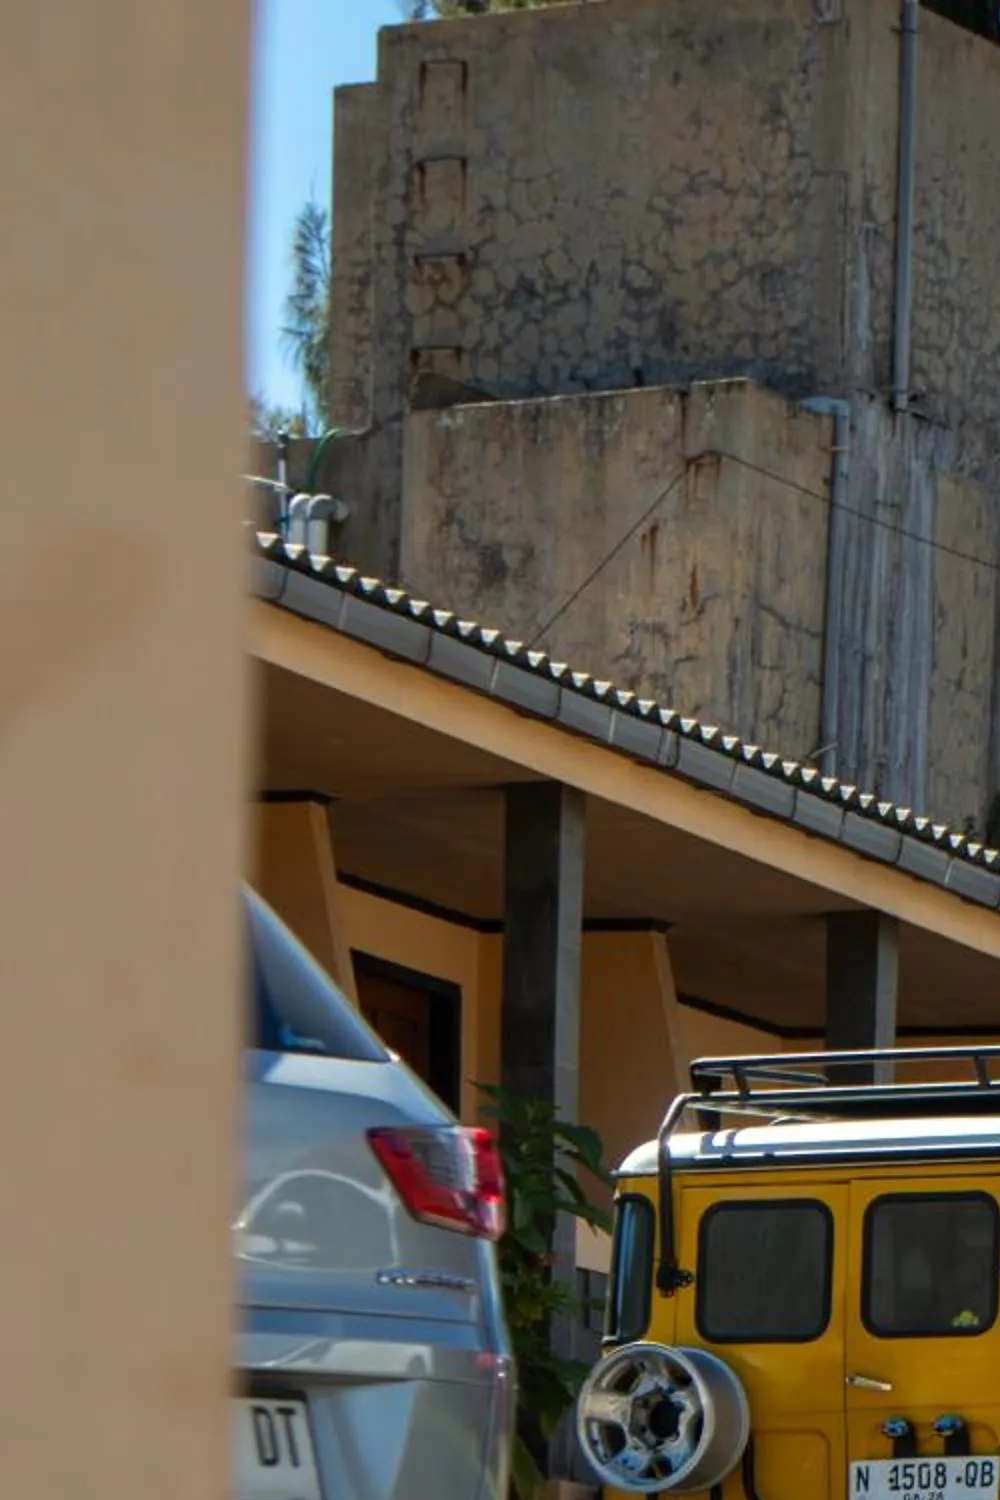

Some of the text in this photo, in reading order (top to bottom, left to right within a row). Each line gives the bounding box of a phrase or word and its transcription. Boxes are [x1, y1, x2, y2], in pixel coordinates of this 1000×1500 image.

[250, 1404, 301, 1468] DT
[855, 1460, 995, 1491] N 1508 QB
